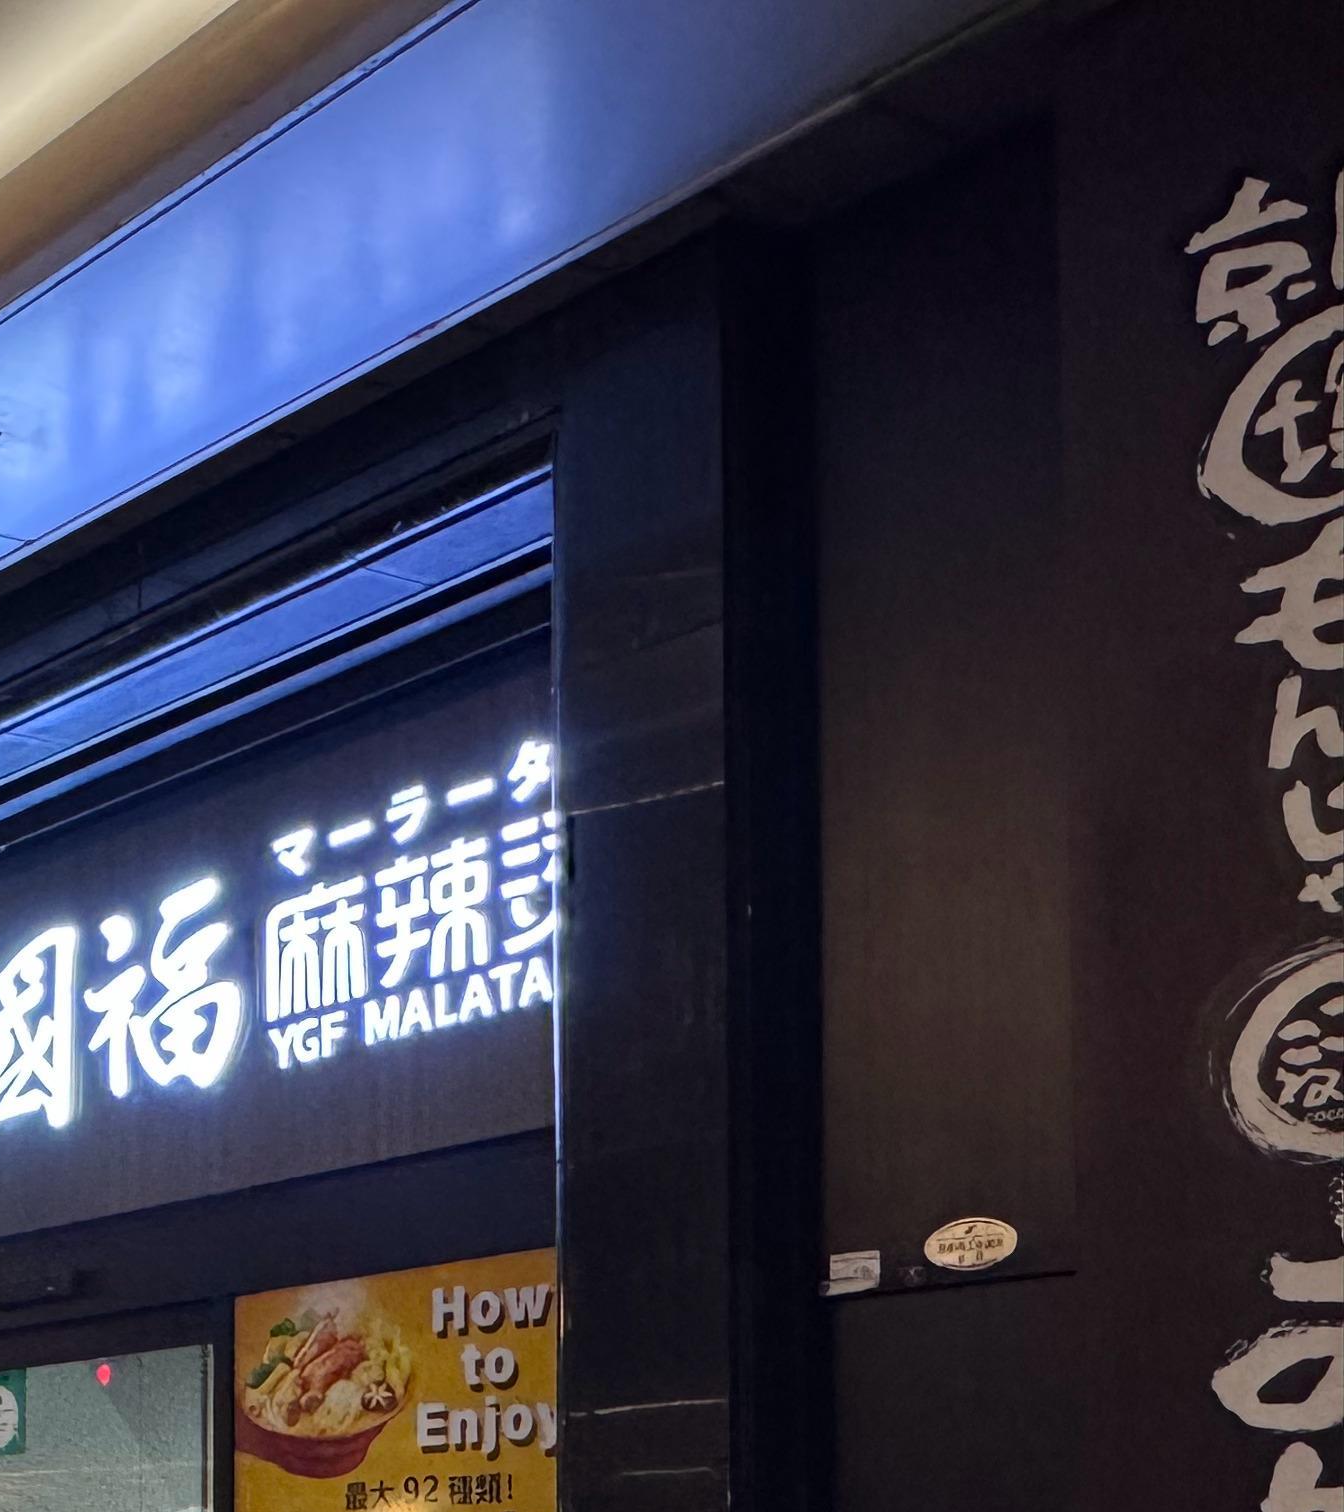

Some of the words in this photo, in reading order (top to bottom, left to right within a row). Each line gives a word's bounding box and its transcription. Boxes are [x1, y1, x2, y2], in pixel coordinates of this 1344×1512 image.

[268, 1010, 348, 1069] YGF
[432, 1284, 552, 1337] How
[461, 1344, 518, 1389] to
